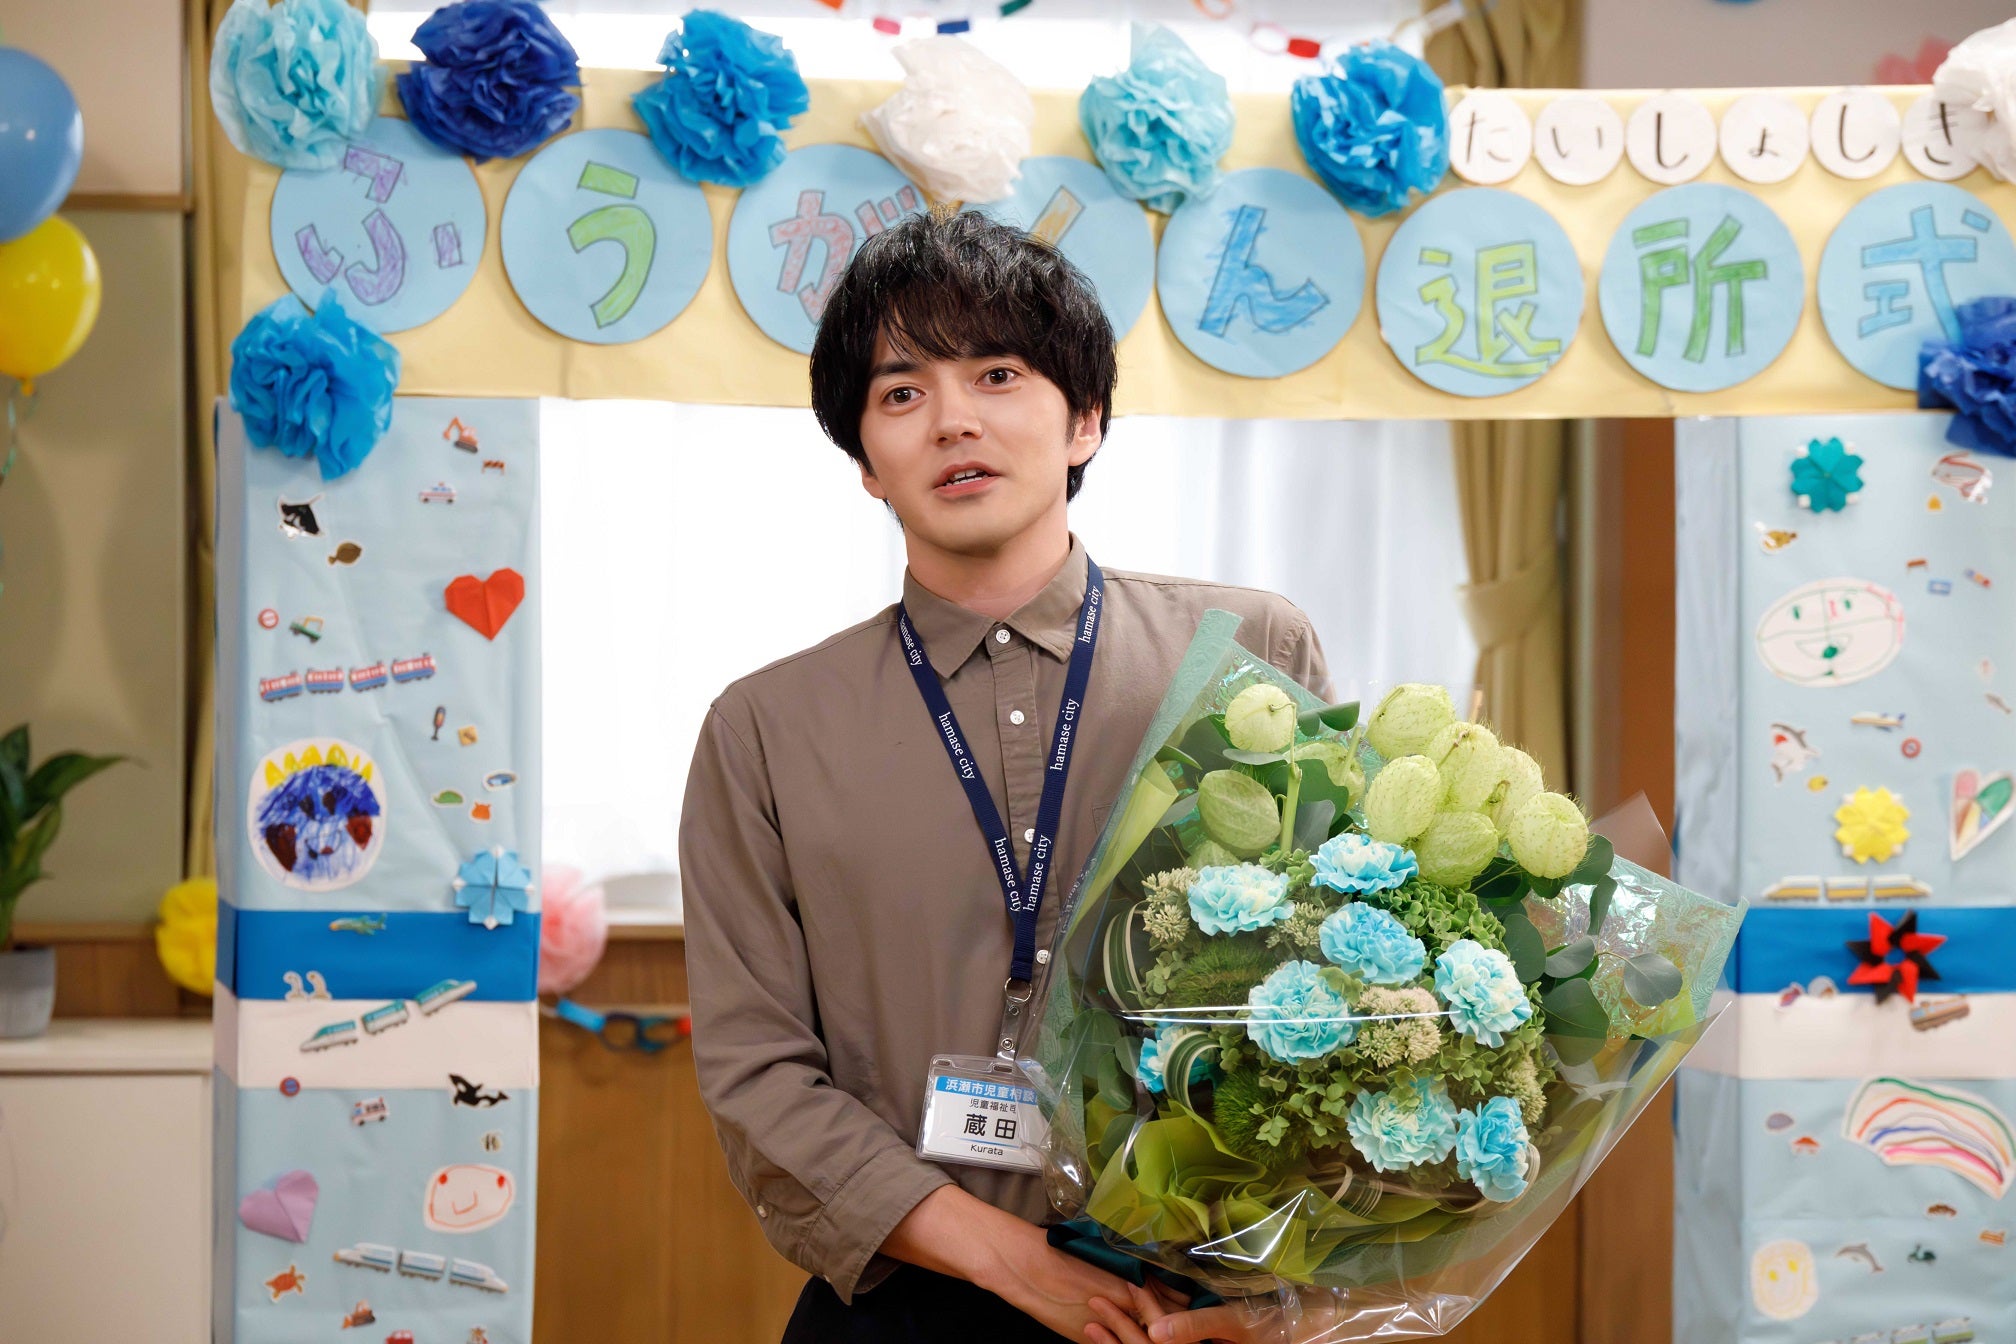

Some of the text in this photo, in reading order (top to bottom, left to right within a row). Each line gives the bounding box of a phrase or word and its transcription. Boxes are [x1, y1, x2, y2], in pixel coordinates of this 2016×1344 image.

[1467, 101, 1960, 170] たいしょしき
[1078, 585, 1102, 643] hamase city
[910, 649, 923, 666] city
[939, 711, 976, 779] hamase city
[1050, 698, 1080, 771] hamase city
[995, 837, 1024, 913] hamase city
[1023, 834, 1051, 912] hamase city
[945, 1079, 1038, 1103] 浜瀬市児童相談
[970, 1144, 1004, 1156] Kurata
